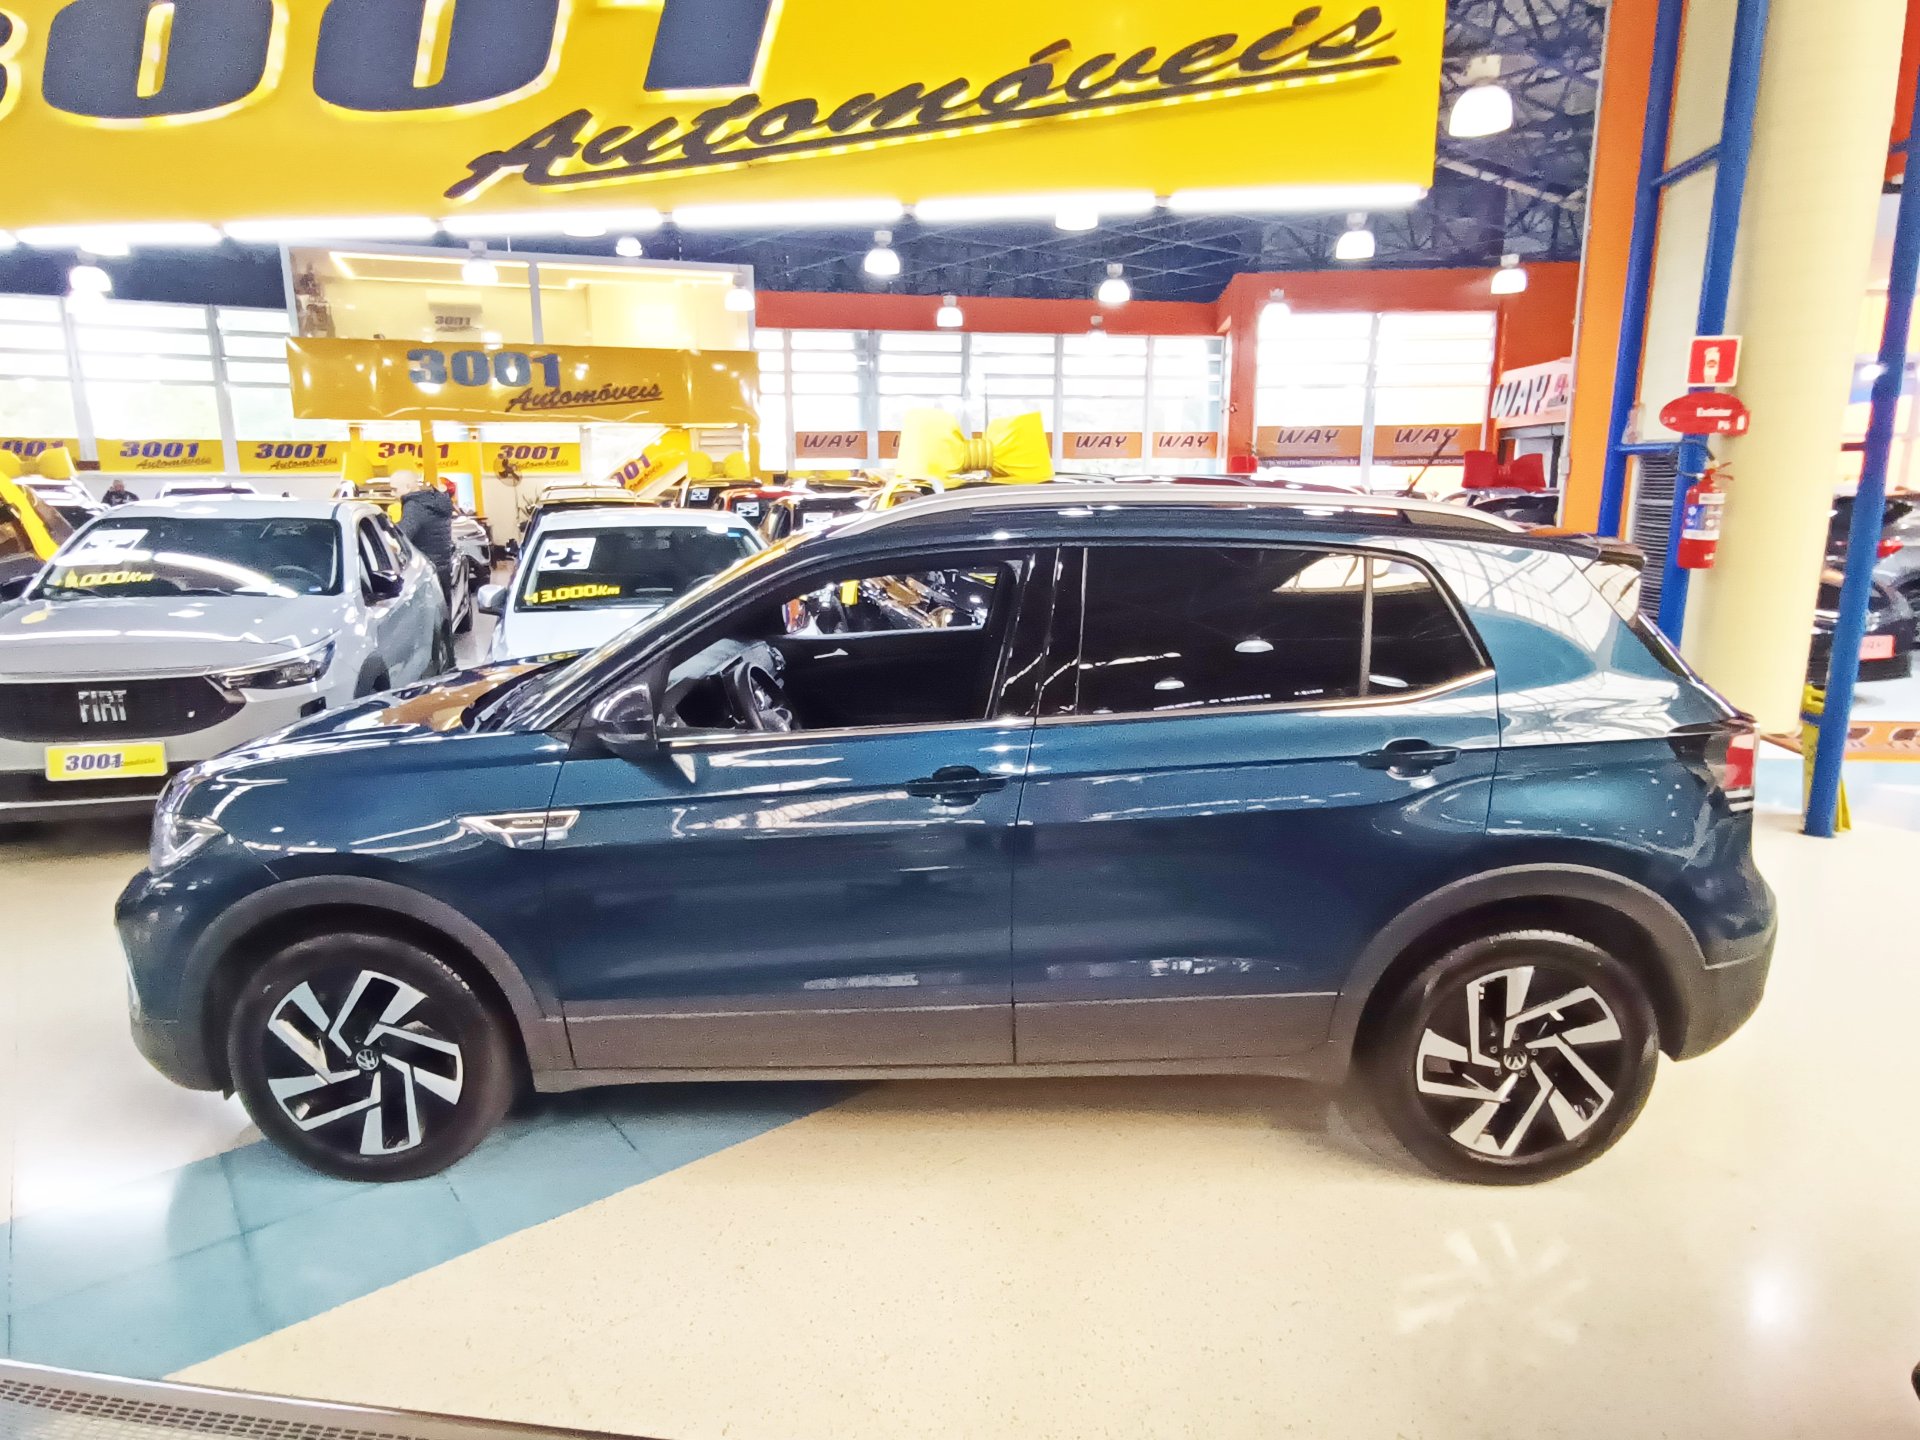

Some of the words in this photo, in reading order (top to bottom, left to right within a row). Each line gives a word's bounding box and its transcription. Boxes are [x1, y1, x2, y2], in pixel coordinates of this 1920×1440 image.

[0, 0, 776, 121] 001
[443, 5, 1402, 201] Automóveis
[406, 347, 561, 388] 3001
[504, 382, 665, 413] Automóveis
[1491, 374, 1552, 418] WAY
[803, 434, 859, 448] WAY
[1075, 435, 1128, 448] WAY
[1158, 435, 1209, 448] WAY
[1277, 428, 1340, 445] WAY
[1393, 427, 1459, 445] WAY
[120, 440, 200, 458] 3001
[255, 442, 328, 459] 3001
[497, 444, 561, 460] 3001
[65, 753, 122, 772] 3001
